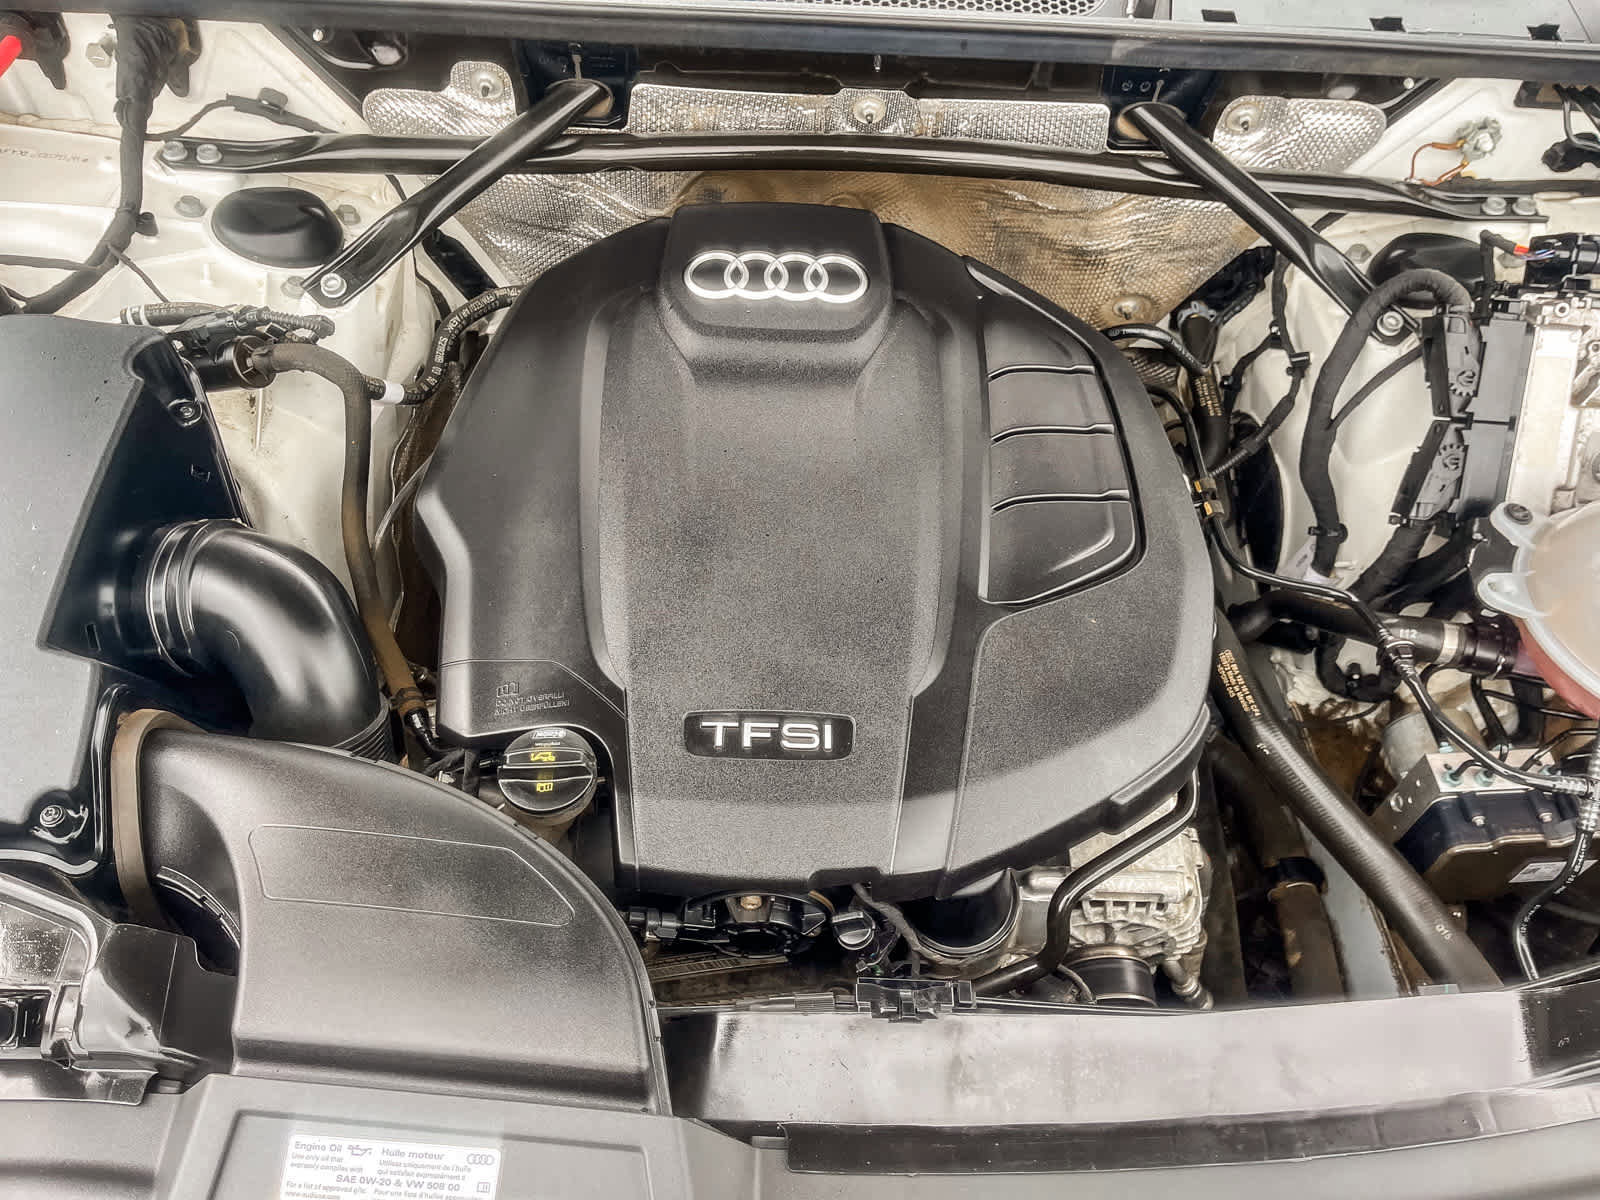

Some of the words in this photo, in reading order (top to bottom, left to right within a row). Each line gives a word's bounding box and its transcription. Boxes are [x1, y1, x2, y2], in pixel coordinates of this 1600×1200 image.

[700, 721, 832, 750] TFSI
[294, 1141, 327, 1152] Engine
[329, 1143, 343, 1153] Oil
[381, 1147, 406, 1158] Huile
[407, 1151, 445, 1160] moteur
[335, 1174, 357, 1184] SAE
[359, 1176, 392, 1186] 0W-20
[393, 1178, 403, 1187] &
[405, 1179, 425, 1189] VW
[426, 1181, 445, 1191] 508
[447, 1183, 460, 1192] 00
